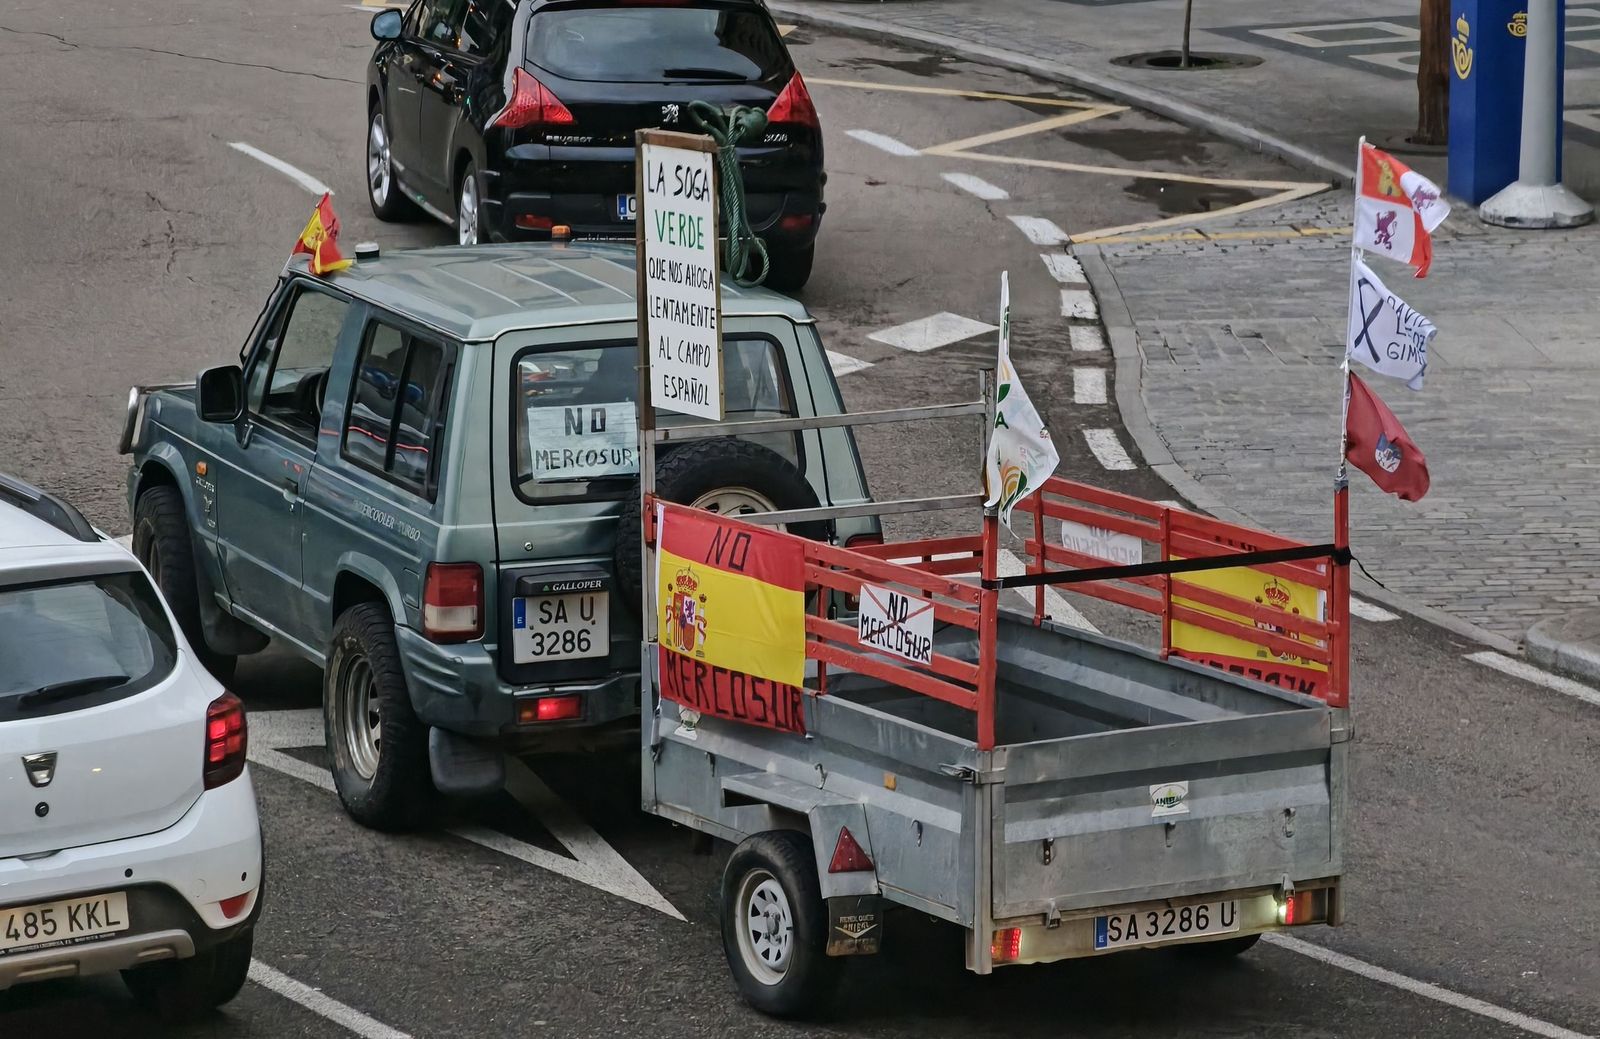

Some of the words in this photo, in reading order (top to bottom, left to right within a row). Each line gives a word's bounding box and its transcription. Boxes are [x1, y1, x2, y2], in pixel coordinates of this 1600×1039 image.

[546, 135, 593, 143] PEUGEOT
[648, 160, 666, 197] LA
[673, 164, 710, 202] SOGA
[655, 209, 704, 250] VERDE
[648, 257, 666, 281] QUE
[668, 260, 683, 284] NOS
[685, 264, 714, 292] AHOGA
[650, 295, 716, 330] LENTAMENTE
[658, 335, 672, 361] AL
[677, 339, 711, 368] CAMPO
[663, 374, 710, 406] ESPAÑOL
[564, 407, 607, 436] NO
[535, 448, 634, 471] MERCOSUR
[706, 526, 752, 572] NO
[552, 580, 602, 591] GALLOPER
[517, 616, 523, 624] E
[539, 599, 569, 625] SA
[580, 596, 594, 622] U
[887, 592, 909, 624] NO
[531, 629, 592, 656] 3286
[860, 613, 931, 662] MERCOSUR
[666, 650, 803, 730] MERCOSUR
[67, 900, 121, 932] KKL
[1108, 914, 1139, 942] SA
[1146, 905, 1210, 937] 3286
[1221, 901, 1235, 927] U
[1098, 935, 1105, 943] E
